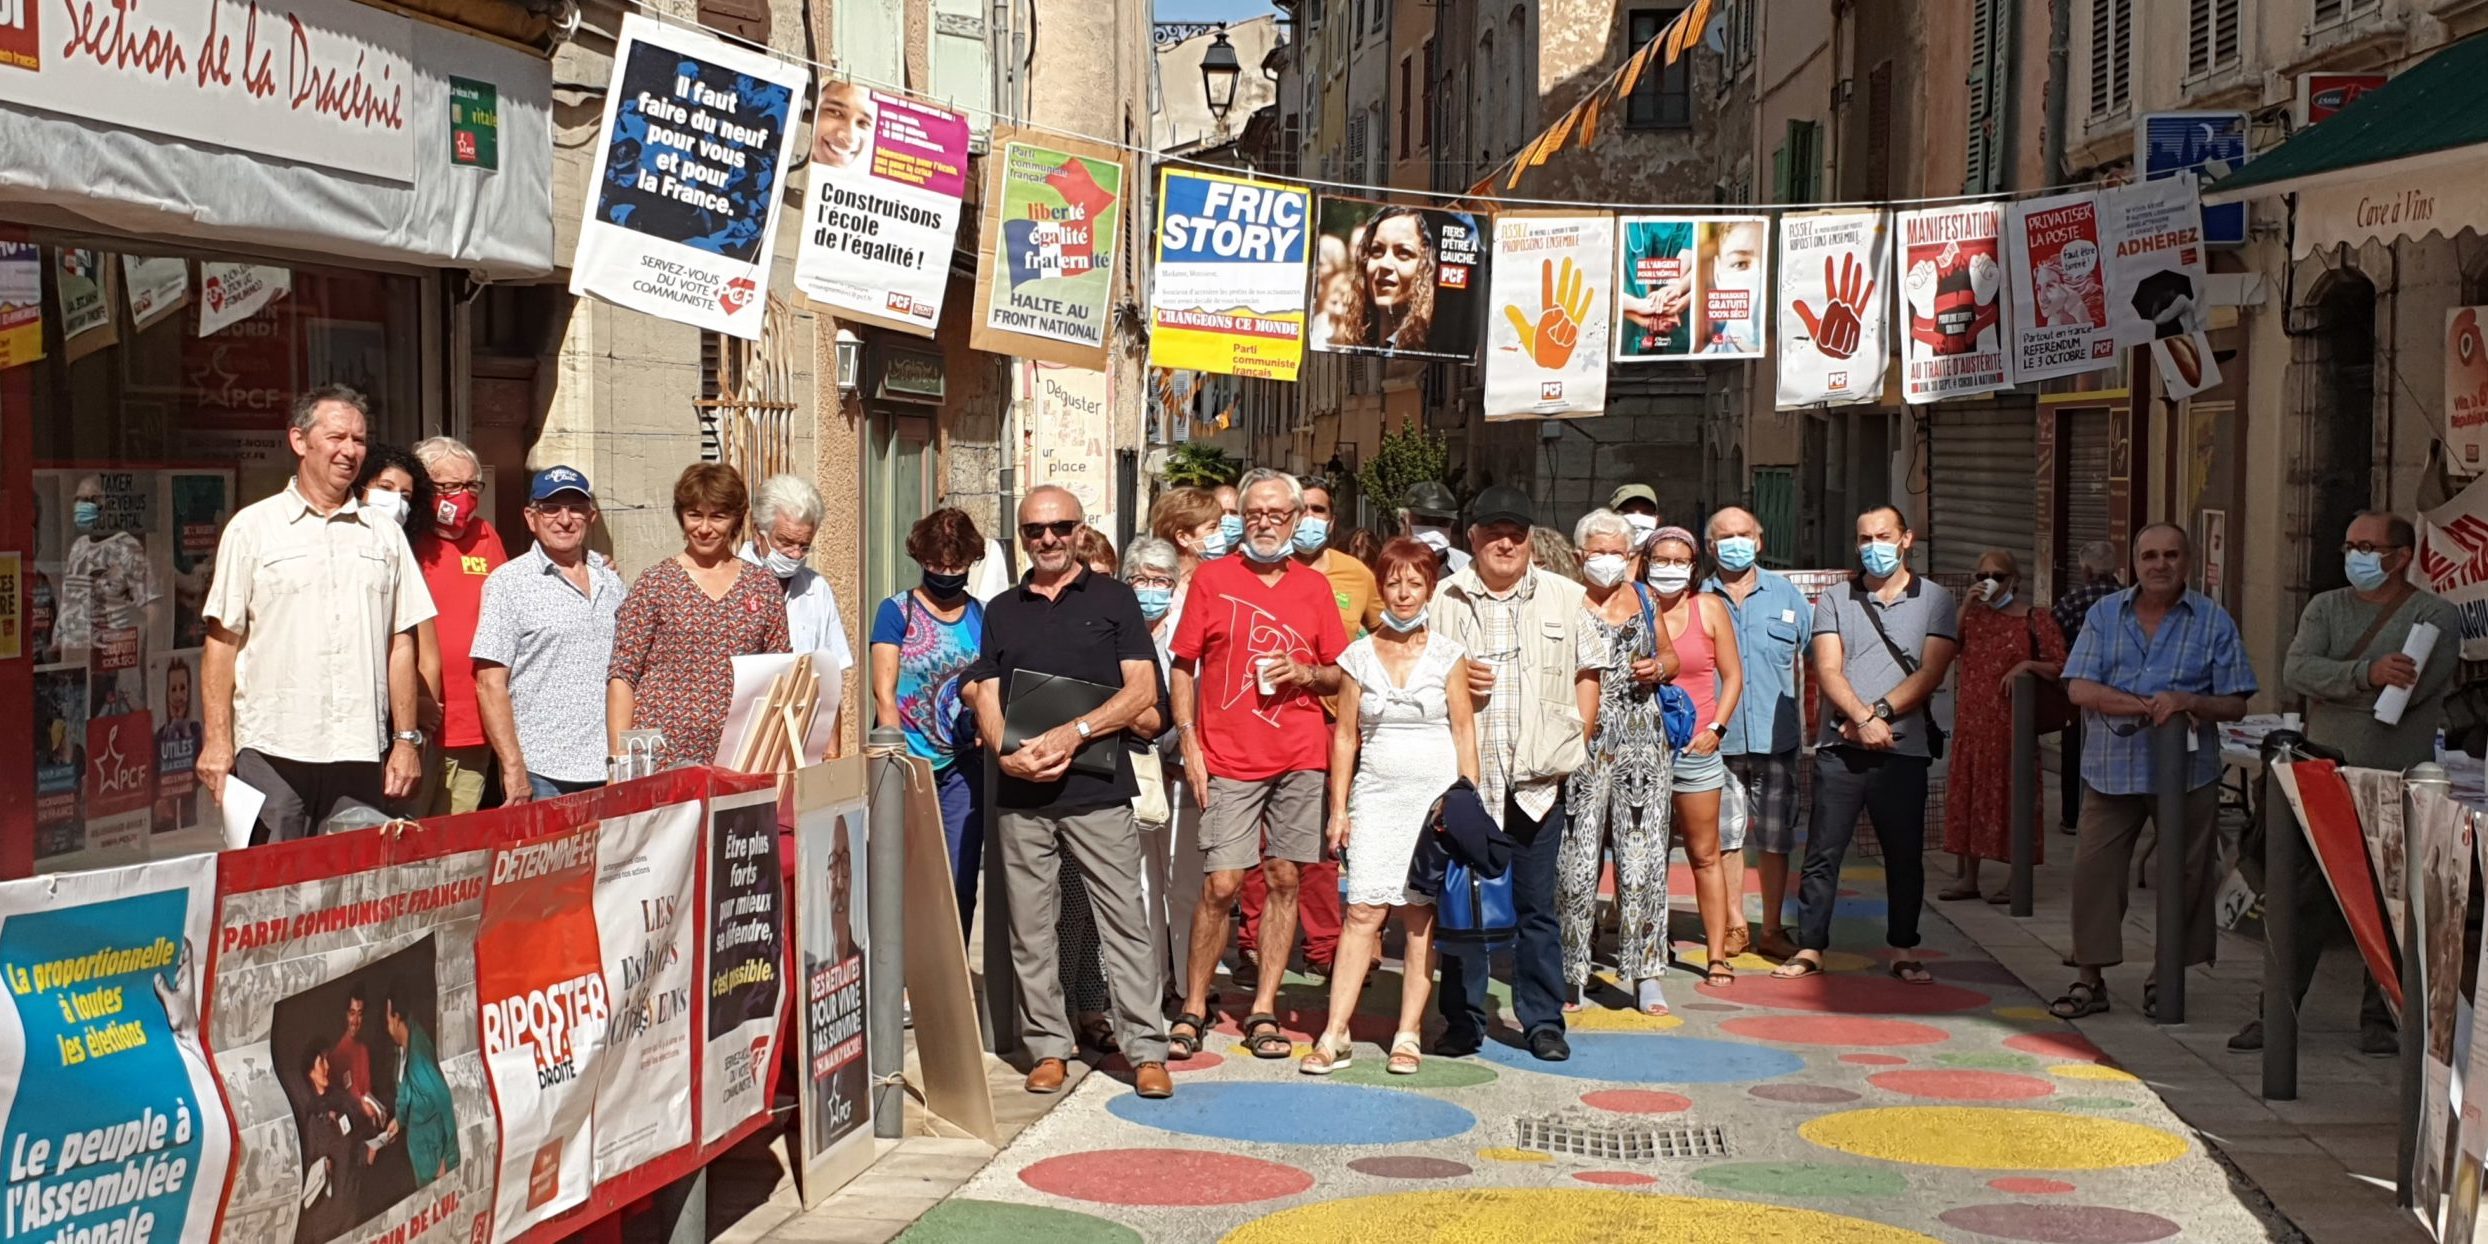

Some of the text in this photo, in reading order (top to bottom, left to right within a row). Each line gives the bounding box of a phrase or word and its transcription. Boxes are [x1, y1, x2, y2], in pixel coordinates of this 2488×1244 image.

[64, 0, 402, 130] Section de la Dracénie
[675, 75, 738, 114] Il faut
[639, 93, 768, 149] faire du neuf
[647, 126, 746, 168] pour vous
[1012, 147, 1035, 158] Parti
[656, 154, 729, 190] et pour
[637, 174, 735, 217] la France.
[821, 182, 942, 230] Construisons
[1203, 182, 1302, 228] FRIC
[2357, 189, 2435, 228] Cave à Vins
[818, 205, 879, 236] l'école
[1028, 203, 1085, 220] liberté
[2028, 205, 2093, 231] PRIVATISER
[1029, 226, 1088, 246] égalité
[1162, 214, 1300, 262] STORY
[1442, 226, 1466, 238] FIERS
[1789, 221, 1813, 238] ASSEZ
[1907, 211, 1999, 244] MANIFESTATION
[815, 228, 837, 247] de
[841, 231, 913, 268] l'égalité
[2030, 235, 2044, 248] LA
[641, 255, 720, 285] SERVEZ-VOUS
[1025, 251, 1110, 269] fraternité
[1440, 253, 1477, 264] GAUCHE.
[657, 273, 710, 295] DU VOTE
[1441, 267, 1465, 283] PCF
[633, 280, 714, 311] COMMUNISTE
[889, 294, 910, 308] PCF
[1011, 293, 1089, 319] HALTE AU
[1708, 300, 1748, 310] GRATUITS
[993, 309, 1098, 341] FRONT NATIONAL
[1157, 311, 1298, 335] CHANGEONS CE MONDE
[1708, 308, 1748, 318] 100% SÉCU
[2023, 327, 2066, 342] Partout en
[1233, 344, 1257, 354] Parti
[2023, 350, 2086, 369] LE 3 OCTOBRE
[2094, 341, 2113, 355] PCF
[1233, 356, 1296, 369] communiste
[1911, 363, 1921, 379] AU
[1543, 384, 1562, 397] PCF
[1829, 373, 1846, 387] PCF
[1046, 379, 1102, 415] Déguster
[1050, 461, 1086, 477] place
[461, 556, 488, 572] PCF
[161, 738, 193, 760] UTILES
[120, 764, 147, 790] PCF
[725, 830, 768, 861] Être plus
[730, 862, 758, 887] forts
[223, 876, 484, 953] PARTI COMMUNISTE FRANÇAIS
[641, 895, 675, 933] LES
[735, 891, 772, 915] mieux
[716, 933, 725, 953] se
[7, 937, 175, 996] La proportionnelle
[811, 956, 860, 1000] DES RETRAITES
[59, 986, 123, 1025] à toutes
[482, 973, 608, 1056] RIPOSTER
[812, 981, 862, 1031] POUR VIVRE
[58, 1021, 147, 1067] les élections
[812, 1009, 862, 1057] PAS SURVIVRE
[538, 1060, 577, 1090] DROITE
[838, 1100, 852, 1122] PCF
[10, 1098, 192, 1183] Le peuple à
[6, 1153, 188, 1239] l'Assemblée
[410, 1191, 459, 1240] DE LUI.
